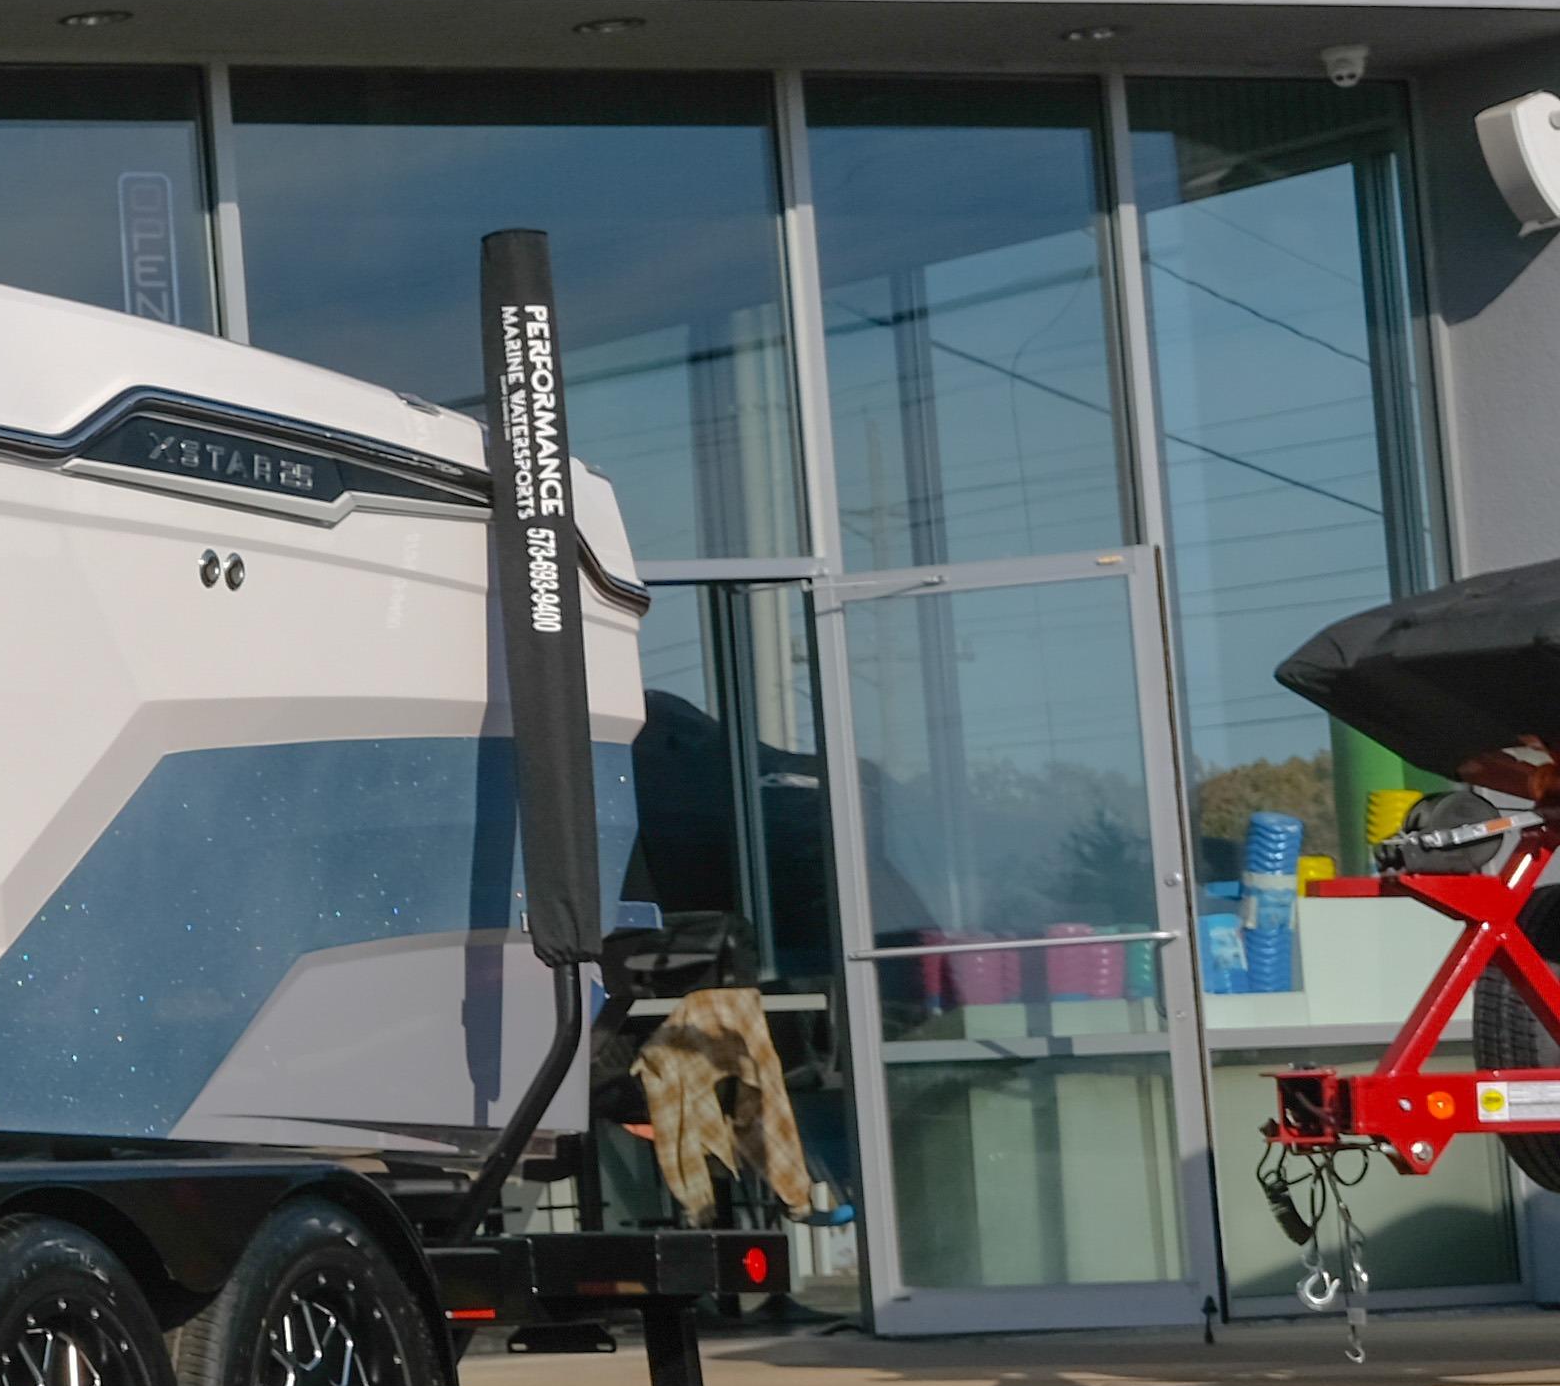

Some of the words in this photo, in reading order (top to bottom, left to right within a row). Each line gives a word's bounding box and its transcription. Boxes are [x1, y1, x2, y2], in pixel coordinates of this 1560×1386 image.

[501, 305, 525, 385] MARINE
[523, 304, 565, 517] PERFORMANCE
[508, 388, 536, 521] WATERSPORTS
